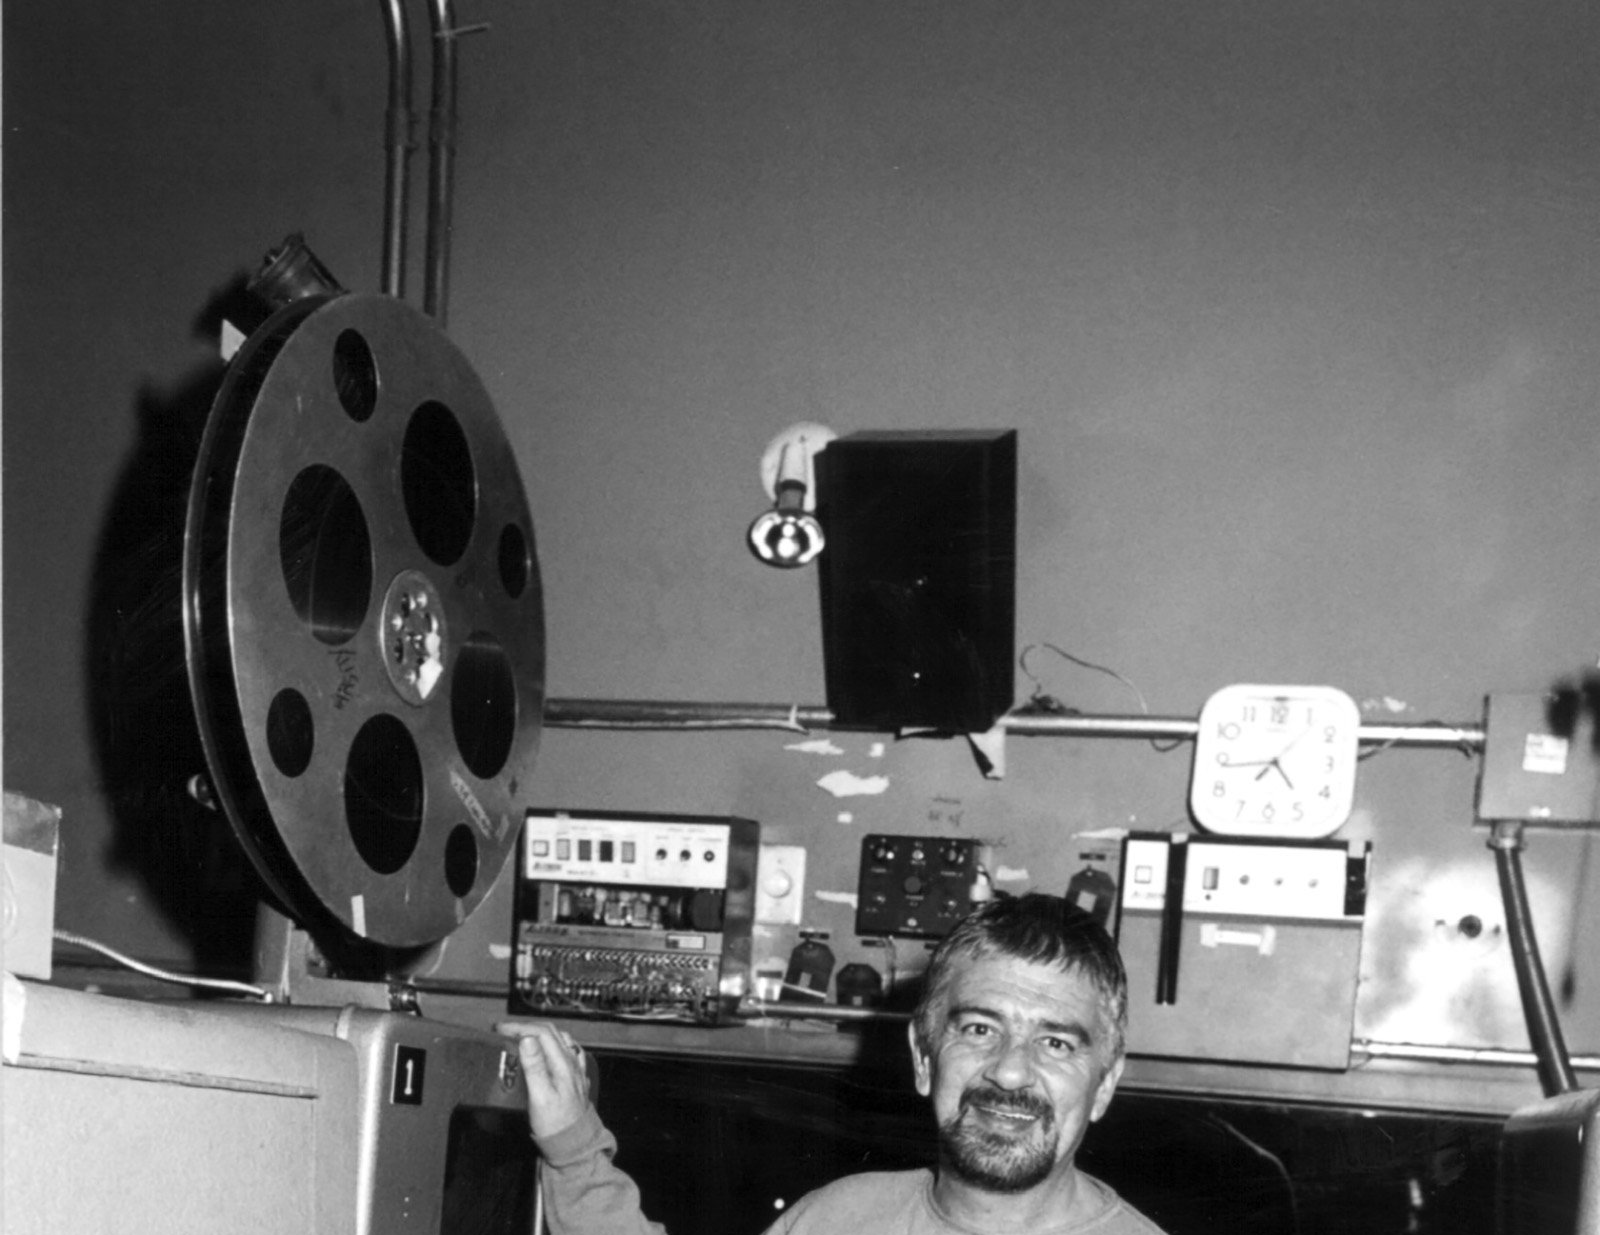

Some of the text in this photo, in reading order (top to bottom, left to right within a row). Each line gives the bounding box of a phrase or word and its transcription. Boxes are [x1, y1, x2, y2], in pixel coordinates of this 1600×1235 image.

[1242, 706, 1257, 723] 11
[1270, 705, 1290, 724] 12
[1306, 707, 1314, 727] 1
[1217, 722, 1241, 740] 10
[1323, 725, 1336, 744] 2
[1215, 751, 1230, 768] 9
[1326, 755, 1335, 773] 3
[1212, 780, 1226, 798] 8
[1317, 784, 1331, 799] 4
[1234, 800, 1246, 818] 7
[1261, 802, 1275, 820] 6
[1292, 801, 1304, 822] 5
[403, 1058, 414, 1095] 1
